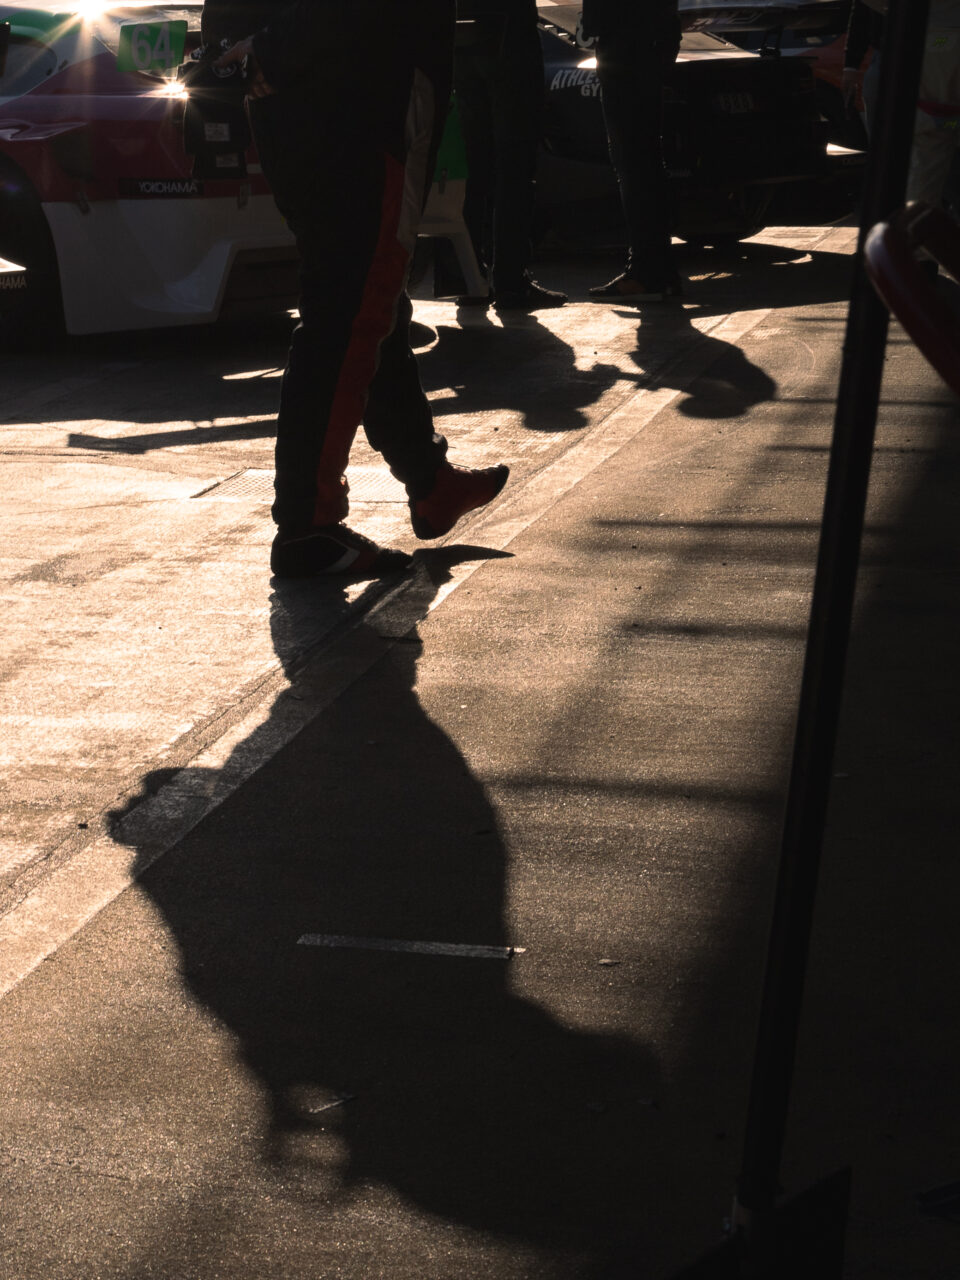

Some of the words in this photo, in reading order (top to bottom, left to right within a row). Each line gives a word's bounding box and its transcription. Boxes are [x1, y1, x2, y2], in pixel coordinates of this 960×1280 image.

[131, 22, 175, 70] 64
[550, 69, 600, 91] ATHLE
[138, 181, 199, 193] YOKOHAMA
